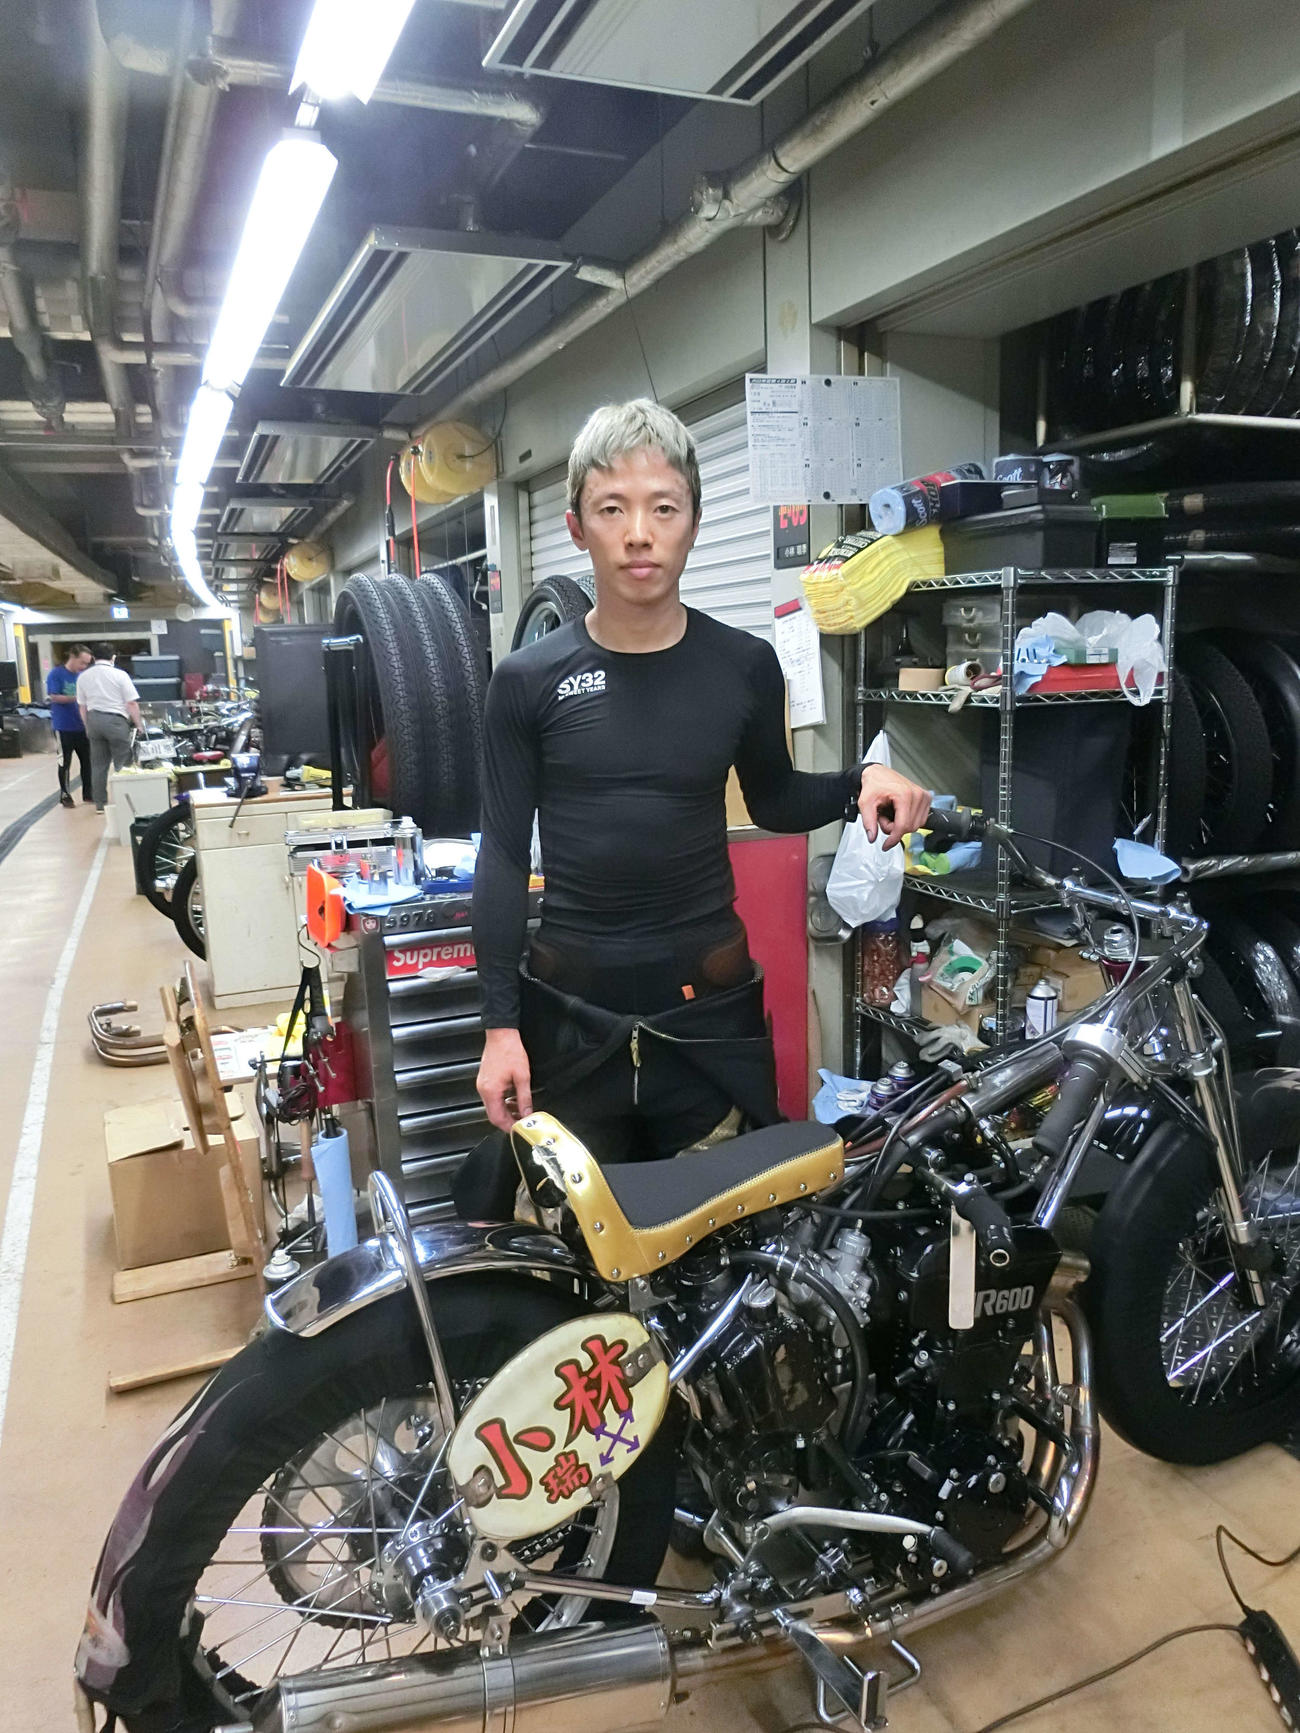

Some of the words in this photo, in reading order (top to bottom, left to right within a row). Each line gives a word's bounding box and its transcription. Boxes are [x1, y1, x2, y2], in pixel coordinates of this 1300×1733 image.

[911, 497, 927, 527] Scott
[557, 670, 606, 695] SY32
[392, 944, 476, 969] Suprem
[475, 1334, 634, 1501] 小林
[539, 1449, 592, 1504] 瑞
